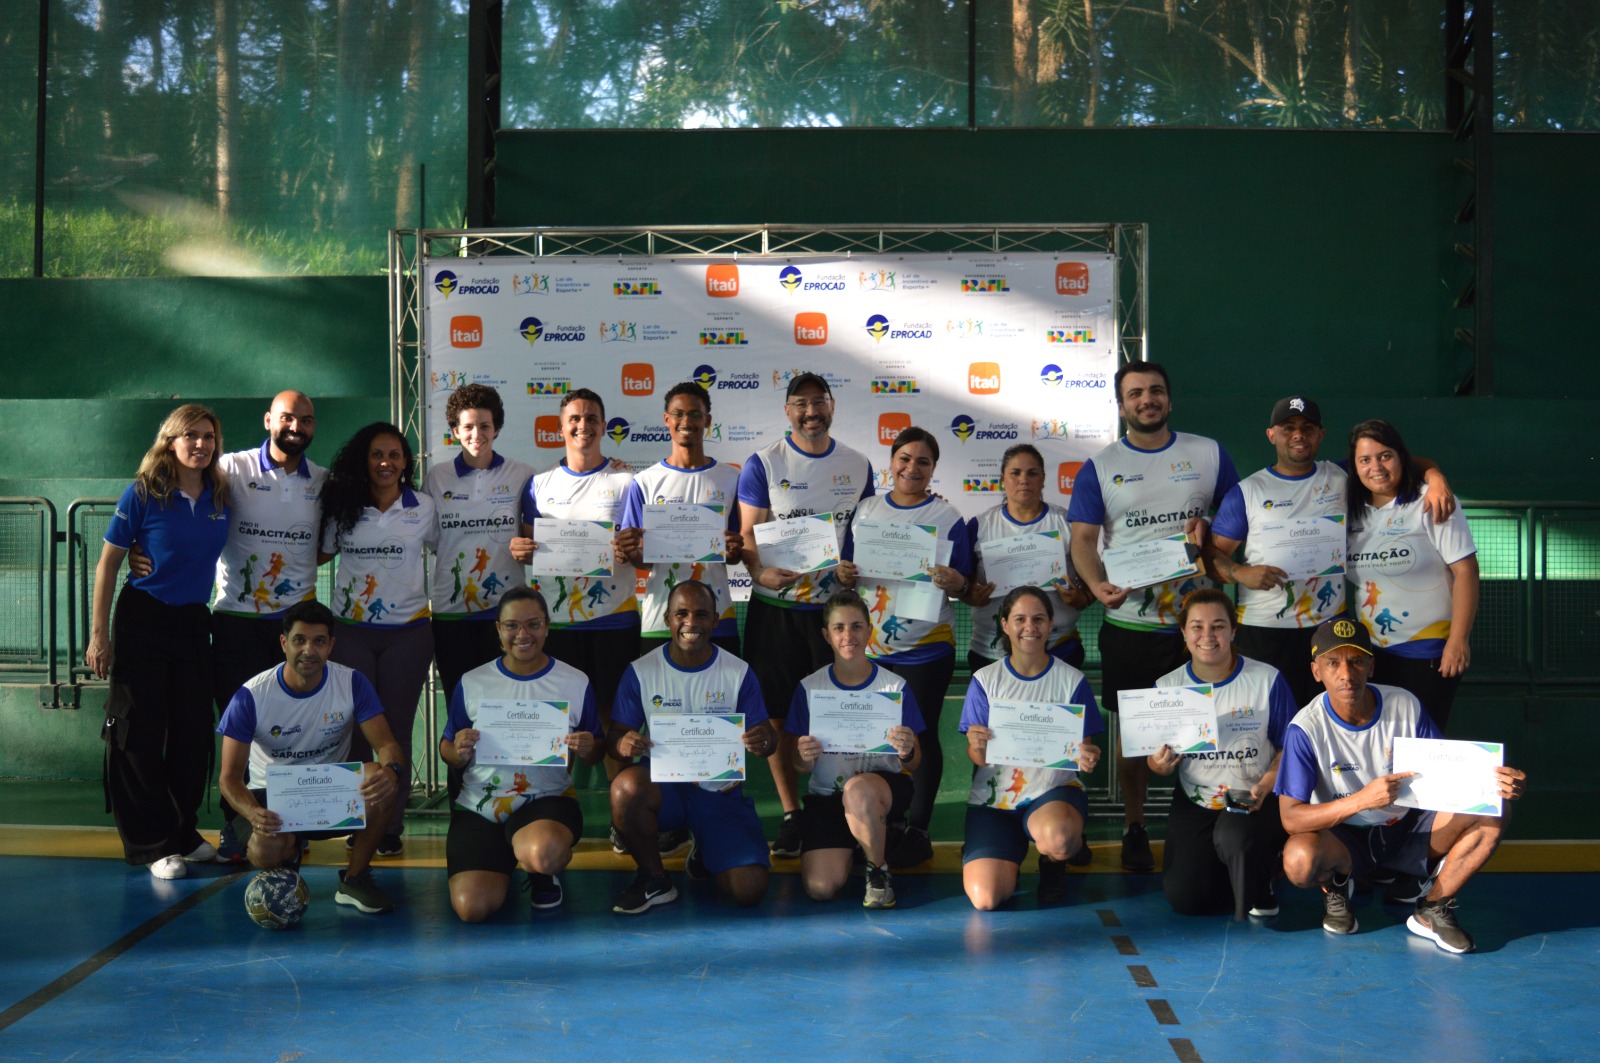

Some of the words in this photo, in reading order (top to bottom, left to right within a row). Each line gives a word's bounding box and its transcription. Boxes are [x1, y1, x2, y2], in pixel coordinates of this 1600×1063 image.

[709, 278, 736, 292] itaú
[804, 282, 845, 290] EPROCAD
[960, 279, 1010, 292] BRASIL
[1058, 276, 1086, 289] itaú
[458, 286, 500, 294] EPROCAD
[613, 282, 662, 295] BRASIL
[453, 329, 479, 342] itaú
[544, 333, 585, 342] EPROCAD
[797, 326, 825, 339] itaú
[890, 330, 932, 339] EPROCAD
[1047, 330, 1096, 343] BRASIL
[699, 332, 748, 345] BRASIL
[624, 377, 651, 390] itaú
[718, 381, 760, 390] EPROCAD
[871, 380, 921, 393] BRASIL
[970, 374, 998, 388] itaú
[631, 433, 672, 442] EPROCAD
[976, 431, 1018, 439] EPROCAD
[442, 515, 514, 529] CAPACITAÇÃO
[670, 514, 699, 522] Certificado
[239, 526, 312, 541] CAPACITAÇÃO
[780, 526, 809, 538] Certificado
[882, 530, 911, 540] Certificado
[1290, 527, 1320, 538] Certificado
[1008, 542, 1037, 554] Certificado
[1132, 546, 1162, 557] Certificado
[840, 701, 873, 710] Certificado
[1149, 700, 1183, 709] Certificado
[507, 711, 539, 720] Certificado
[1019, 713, 1054, 723] Certificado
[681, 727, 714, 736] Certificado
[297, 776, 332, 785] Certificado
